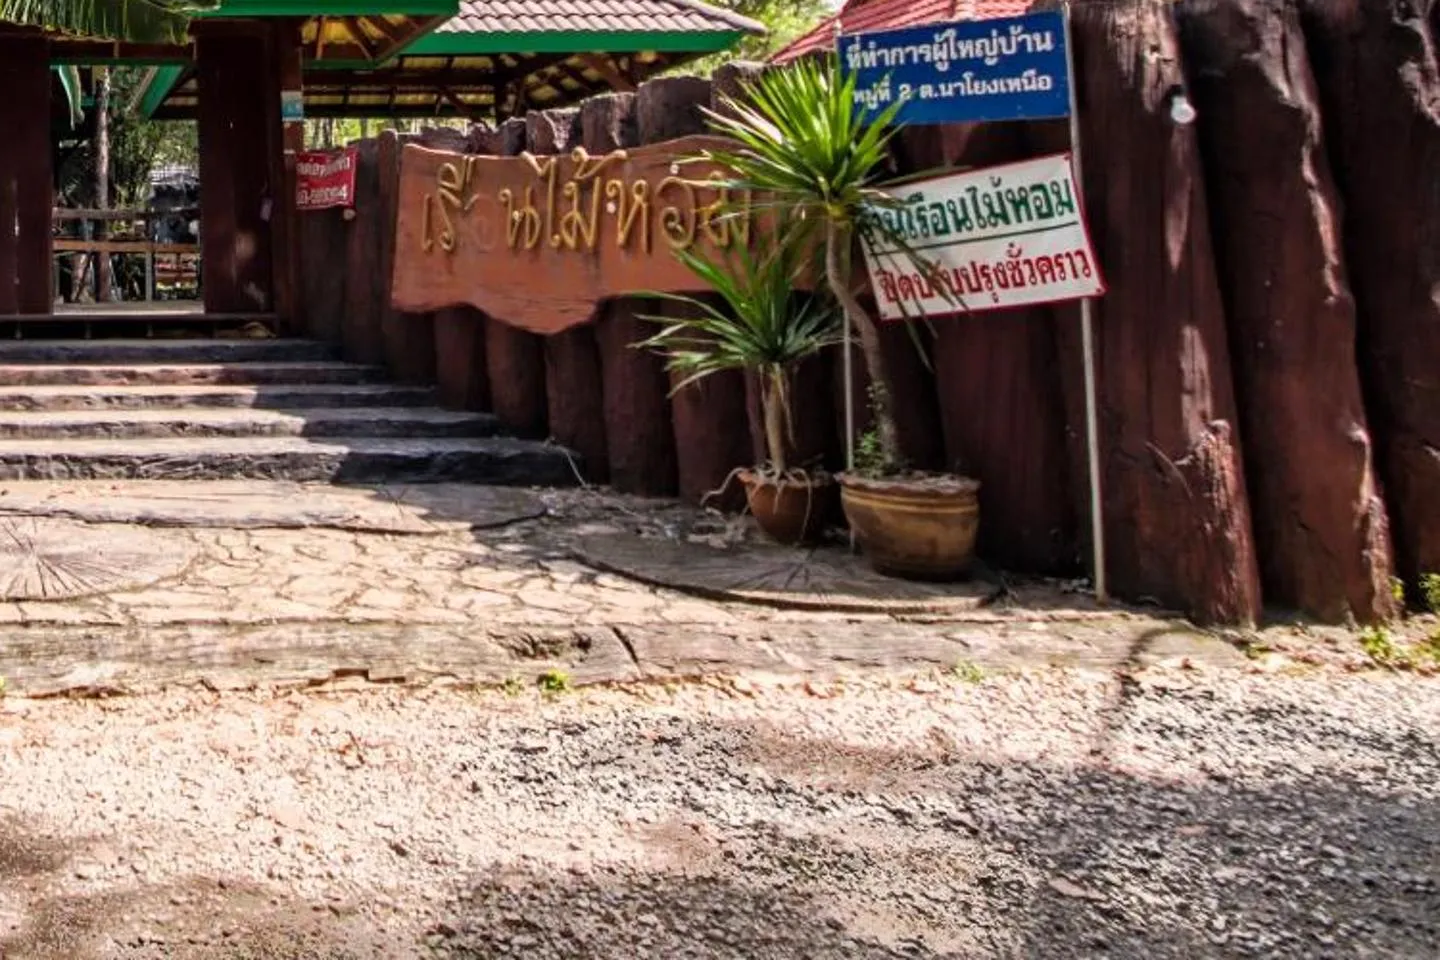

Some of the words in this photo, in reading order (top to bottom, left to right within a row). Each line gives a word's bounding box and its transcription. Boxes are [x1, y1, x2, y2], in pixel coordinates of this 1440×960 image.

[846, 23, 1055, 72] ที่ทำการผู้ใหญ่บ้าน
[898, 82, 912, 101] 2
[919, 69, 1053, 100] ต.นาโยงเหนือ
